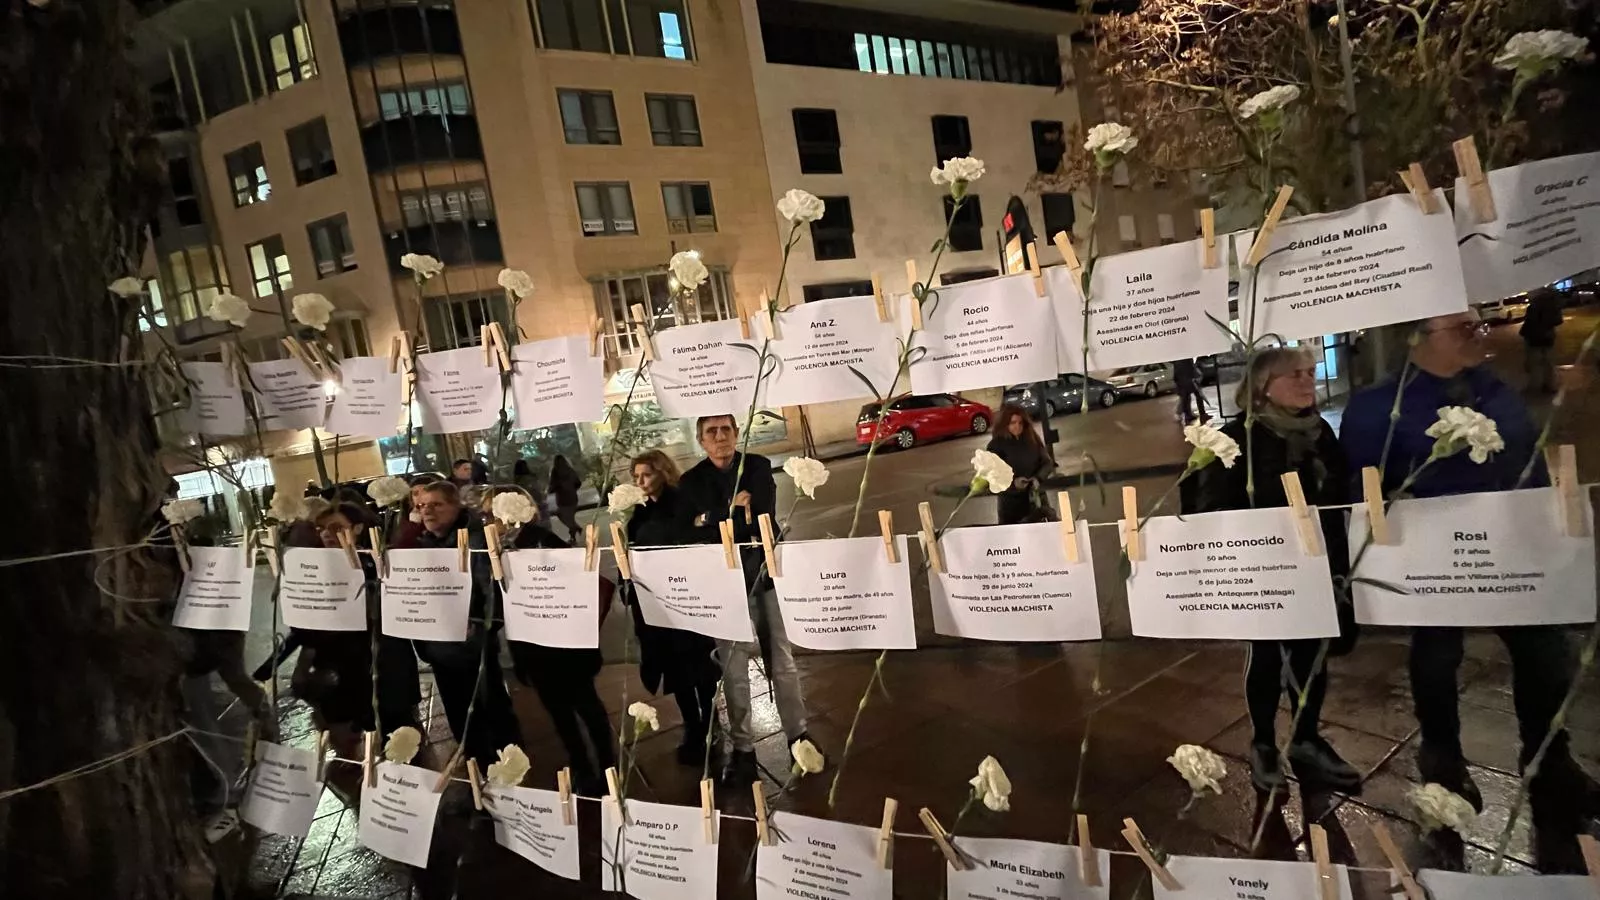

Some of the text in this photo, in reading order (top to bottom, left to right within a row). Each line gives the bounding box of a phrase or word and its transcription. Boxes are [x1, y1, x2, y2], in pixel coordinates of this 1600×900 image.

[1289, 223, 1387, 250] Cándida Molina
[1126, 273, 1152, 284] Laila
[1303, 275, 1313, 283] 23
[1359, 262, 1380, 272] 2024
[1339, 279, 1352, 288] del
[1354, 277, 1370, 285] Rey
[1290, 282, 1401, 310] VIOLENCIA MACHISTA
[1109, 314, 1117, 322] 22
[1158, 305, 1176, 314] 2024
[1100, 326, 1187, 345] VIOLENCIA MACHISTA
[698, 342, 722, 351] Dahan
[795, 357, 863, 370] VIOLENCIA MACHISTA
[945, 353, 1019, 369] VIOLENCIA MACHISTA
[708, 385, 737, 394] MACHISTA
[1454, 532, 1487, 541] Rosi
[986, 547, 1020, 556] Ammal
[1160, 542, 1205, 552] Nombre
[1227, 537, 1285, 548] conocido
[1231, 602, 1284, 610] MACHISTA
[807, 836, 836, 850] Lorena
[990, 859, 1065, 879] María Elizabeth
[1229, 877, 1269, 891] Yanely
